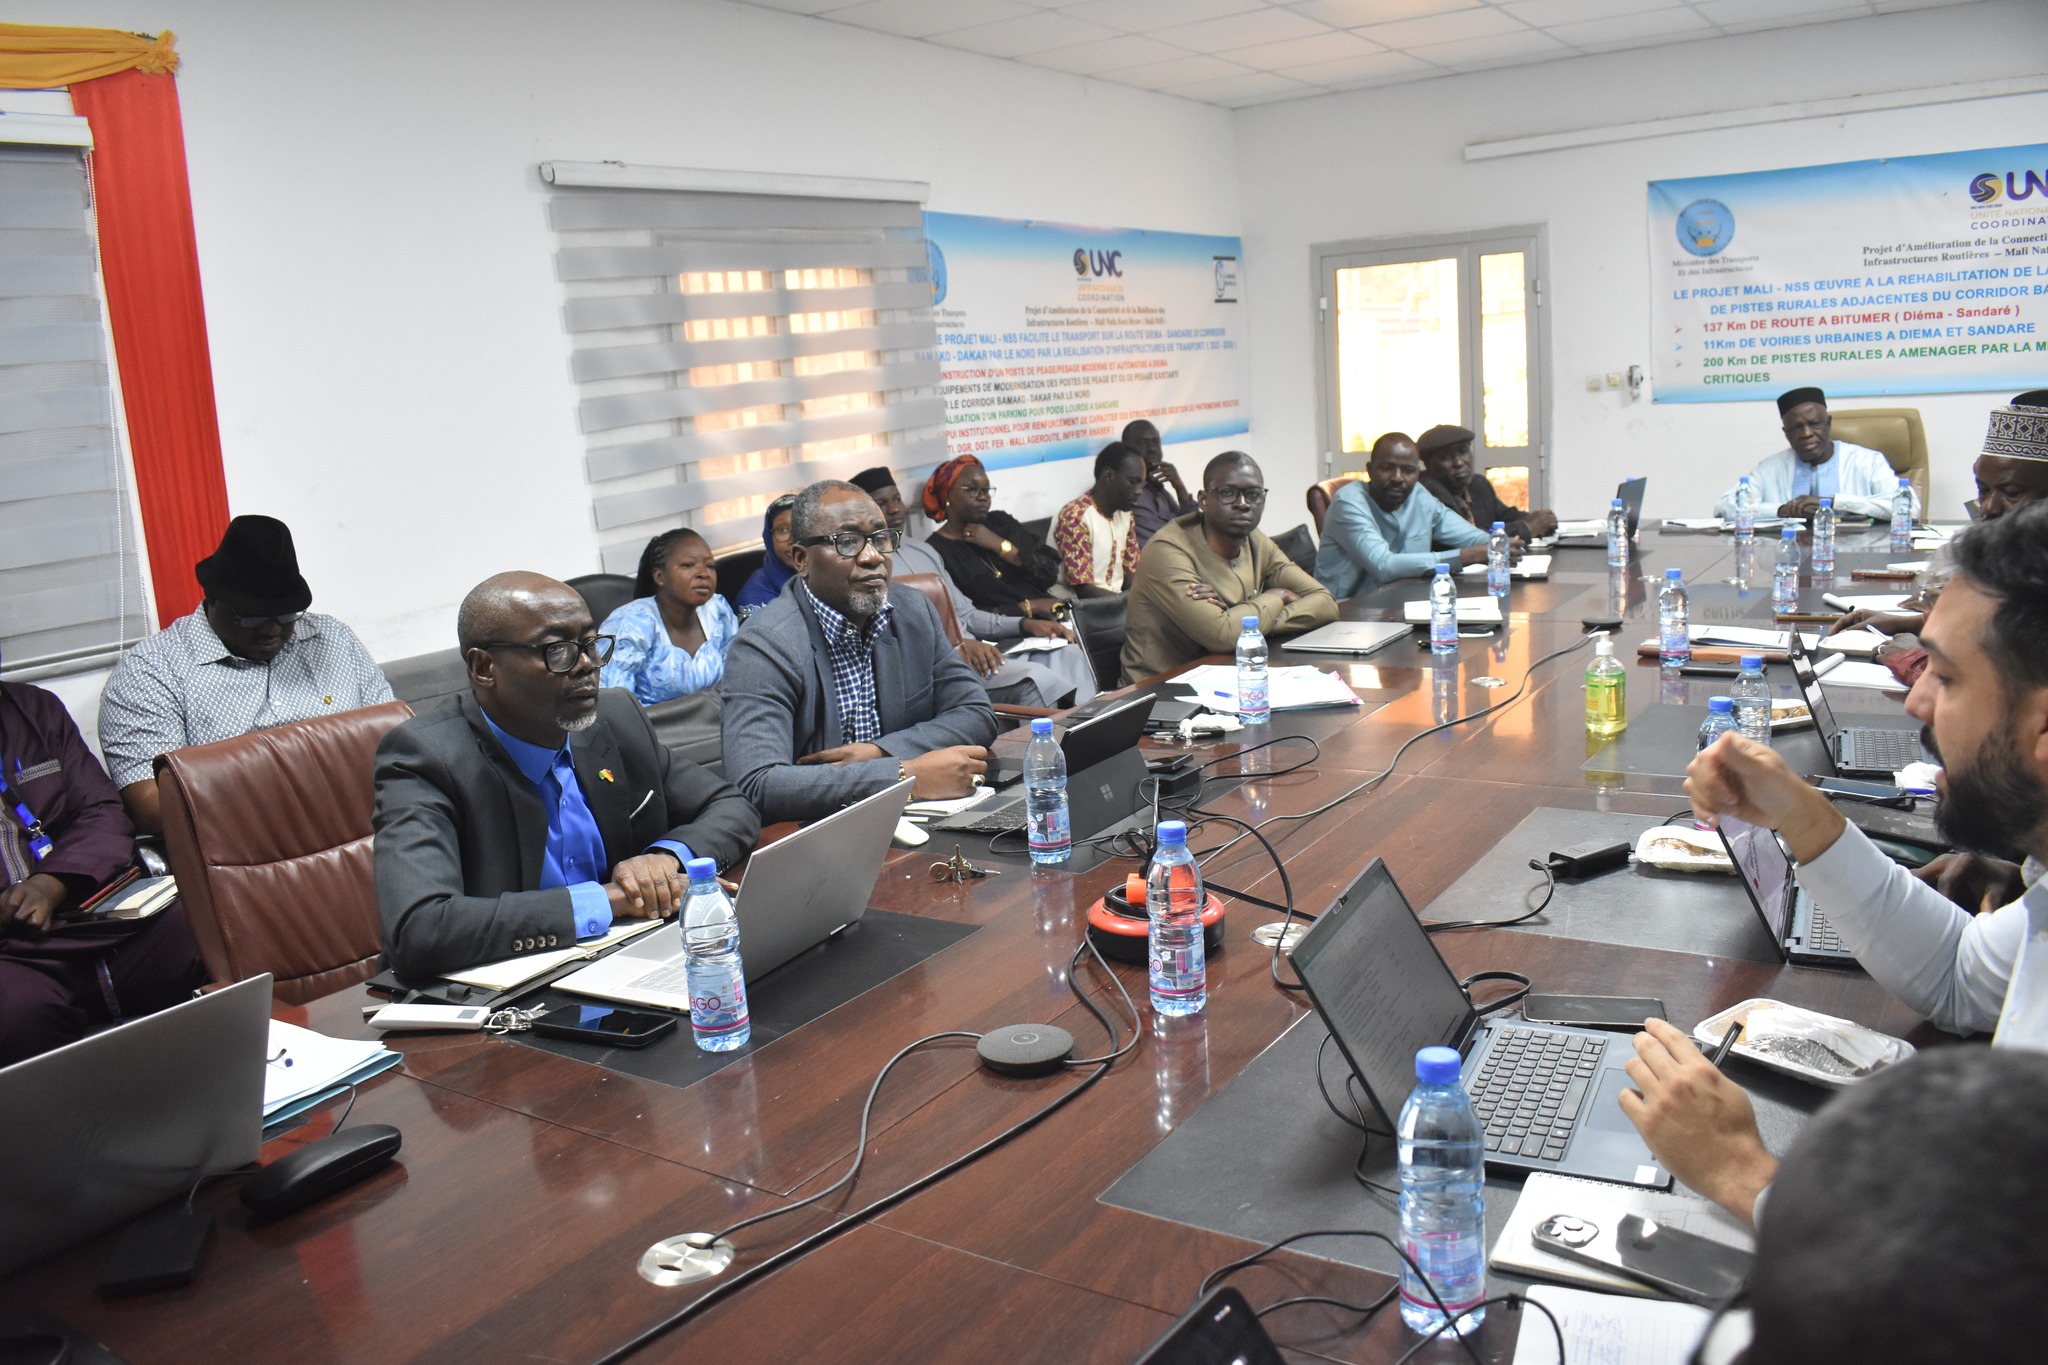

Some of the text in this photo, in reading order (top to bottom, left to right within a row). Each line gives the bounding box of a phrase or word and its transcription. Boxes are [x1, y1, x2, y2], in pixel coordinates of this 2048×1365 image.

[1970, 216, 2048, 230] COORDINA
[1863, 245, 1892, 255] Projet
[1974, 238, 1986, 247] de
[1989, 236, 1999, 245] la
[1089, 248, 1124, 279] UNC
[1864, 256, 1938, 267] Infrastructures
[1942, 250, 1990, 261] Routières
[2005, 247, 2028, 256] Mali
[1674, 290, 1688, 300] LE
[1692, 286, 1740, 299] PROJET
[1744, 284, 1773, 296] MALI
[1785, 282, 1810, 292] NSS
[1865, 278, 1874, 288] A
[1878, 277, 1894, 287] LA
[1899, 268, 2008, 285] REHABILITATION
[2014, 266, 2032, 278] DE
[1711, 305, 1726, 315] DE
[1731, 302, 1773, 314] PISTES
[1777, 297, 1837, 311] RURALES
[1841, 292, 1928, 306] ADJACENTES
[1932, 290, 1951, 301] DU
[1956, 286, 2029, 300] CORRIDOR
[1703, 305, 2011, 333] 137 Km DE ROUTE A BITUMER Diéma Sandaré
[945, 333, 978, 345] PROJET
[980, 333, 997, 344] MALI
[1003, 334, 1018, 344] NSS
[1052, 332, 1060, 342] LE
[1062, 331, 1100, 341] TRANSPORT
[1704, 323, 2036, 350] 11Km DE VOIRIES URBAINES A DIEMA ET SANDARE
[958, 350, 988, 362] DAKAR
[989, 350, 1002, 360] PAR
[1005, 349, 1014, 359] LE
[1016, 348, 1036, 359] NORD
[1038, 348, 1051, 358] PAR
[1053, 347, 1062, 357] LA
[1064, 345, 1104, 356] REALISATION
[1704, 341, 2048, 368] 200 Km DE PISTES RURALES A AMENAGER PAR LA M
[940, 370, 986, 380] NSTRUCTION
[1005, 367, 1025, 376] POSTE
[1027, 366, 1035, 376] DE
[1704, 373, 1770, 385] CRITIQUES
[983, 383, 992, 392] DE
[994, 380, 1045, 391] MODERNISATION
[1046, 379, 1058, 388] DES
[1060, 377, 1081, 386] POSTES
[1083, 376, 1090, 385] DE
[950, 400, 959, 409] LE
[962, 398, 995, 408] CORRIDOR
[997, 395, 1026, 406] BAMAKO
[1030, 393, 1052, 402] DAKAR
[1053, 392, 1064, 401] PAR
[1066, 391, 1073, 400] LE
[945, 414, 980, 425] ALISATION
[999, 409, 1027, 419] PARKING
[1029, 407, 1044, 417] POUR
[1046, 405, 1064, 414] POIDS
[959, 424, 1011, 438] INSTITUTIONNEL
[1013, 422, 1030, 432] POUR
[992, 439, 1005, 449] FER
